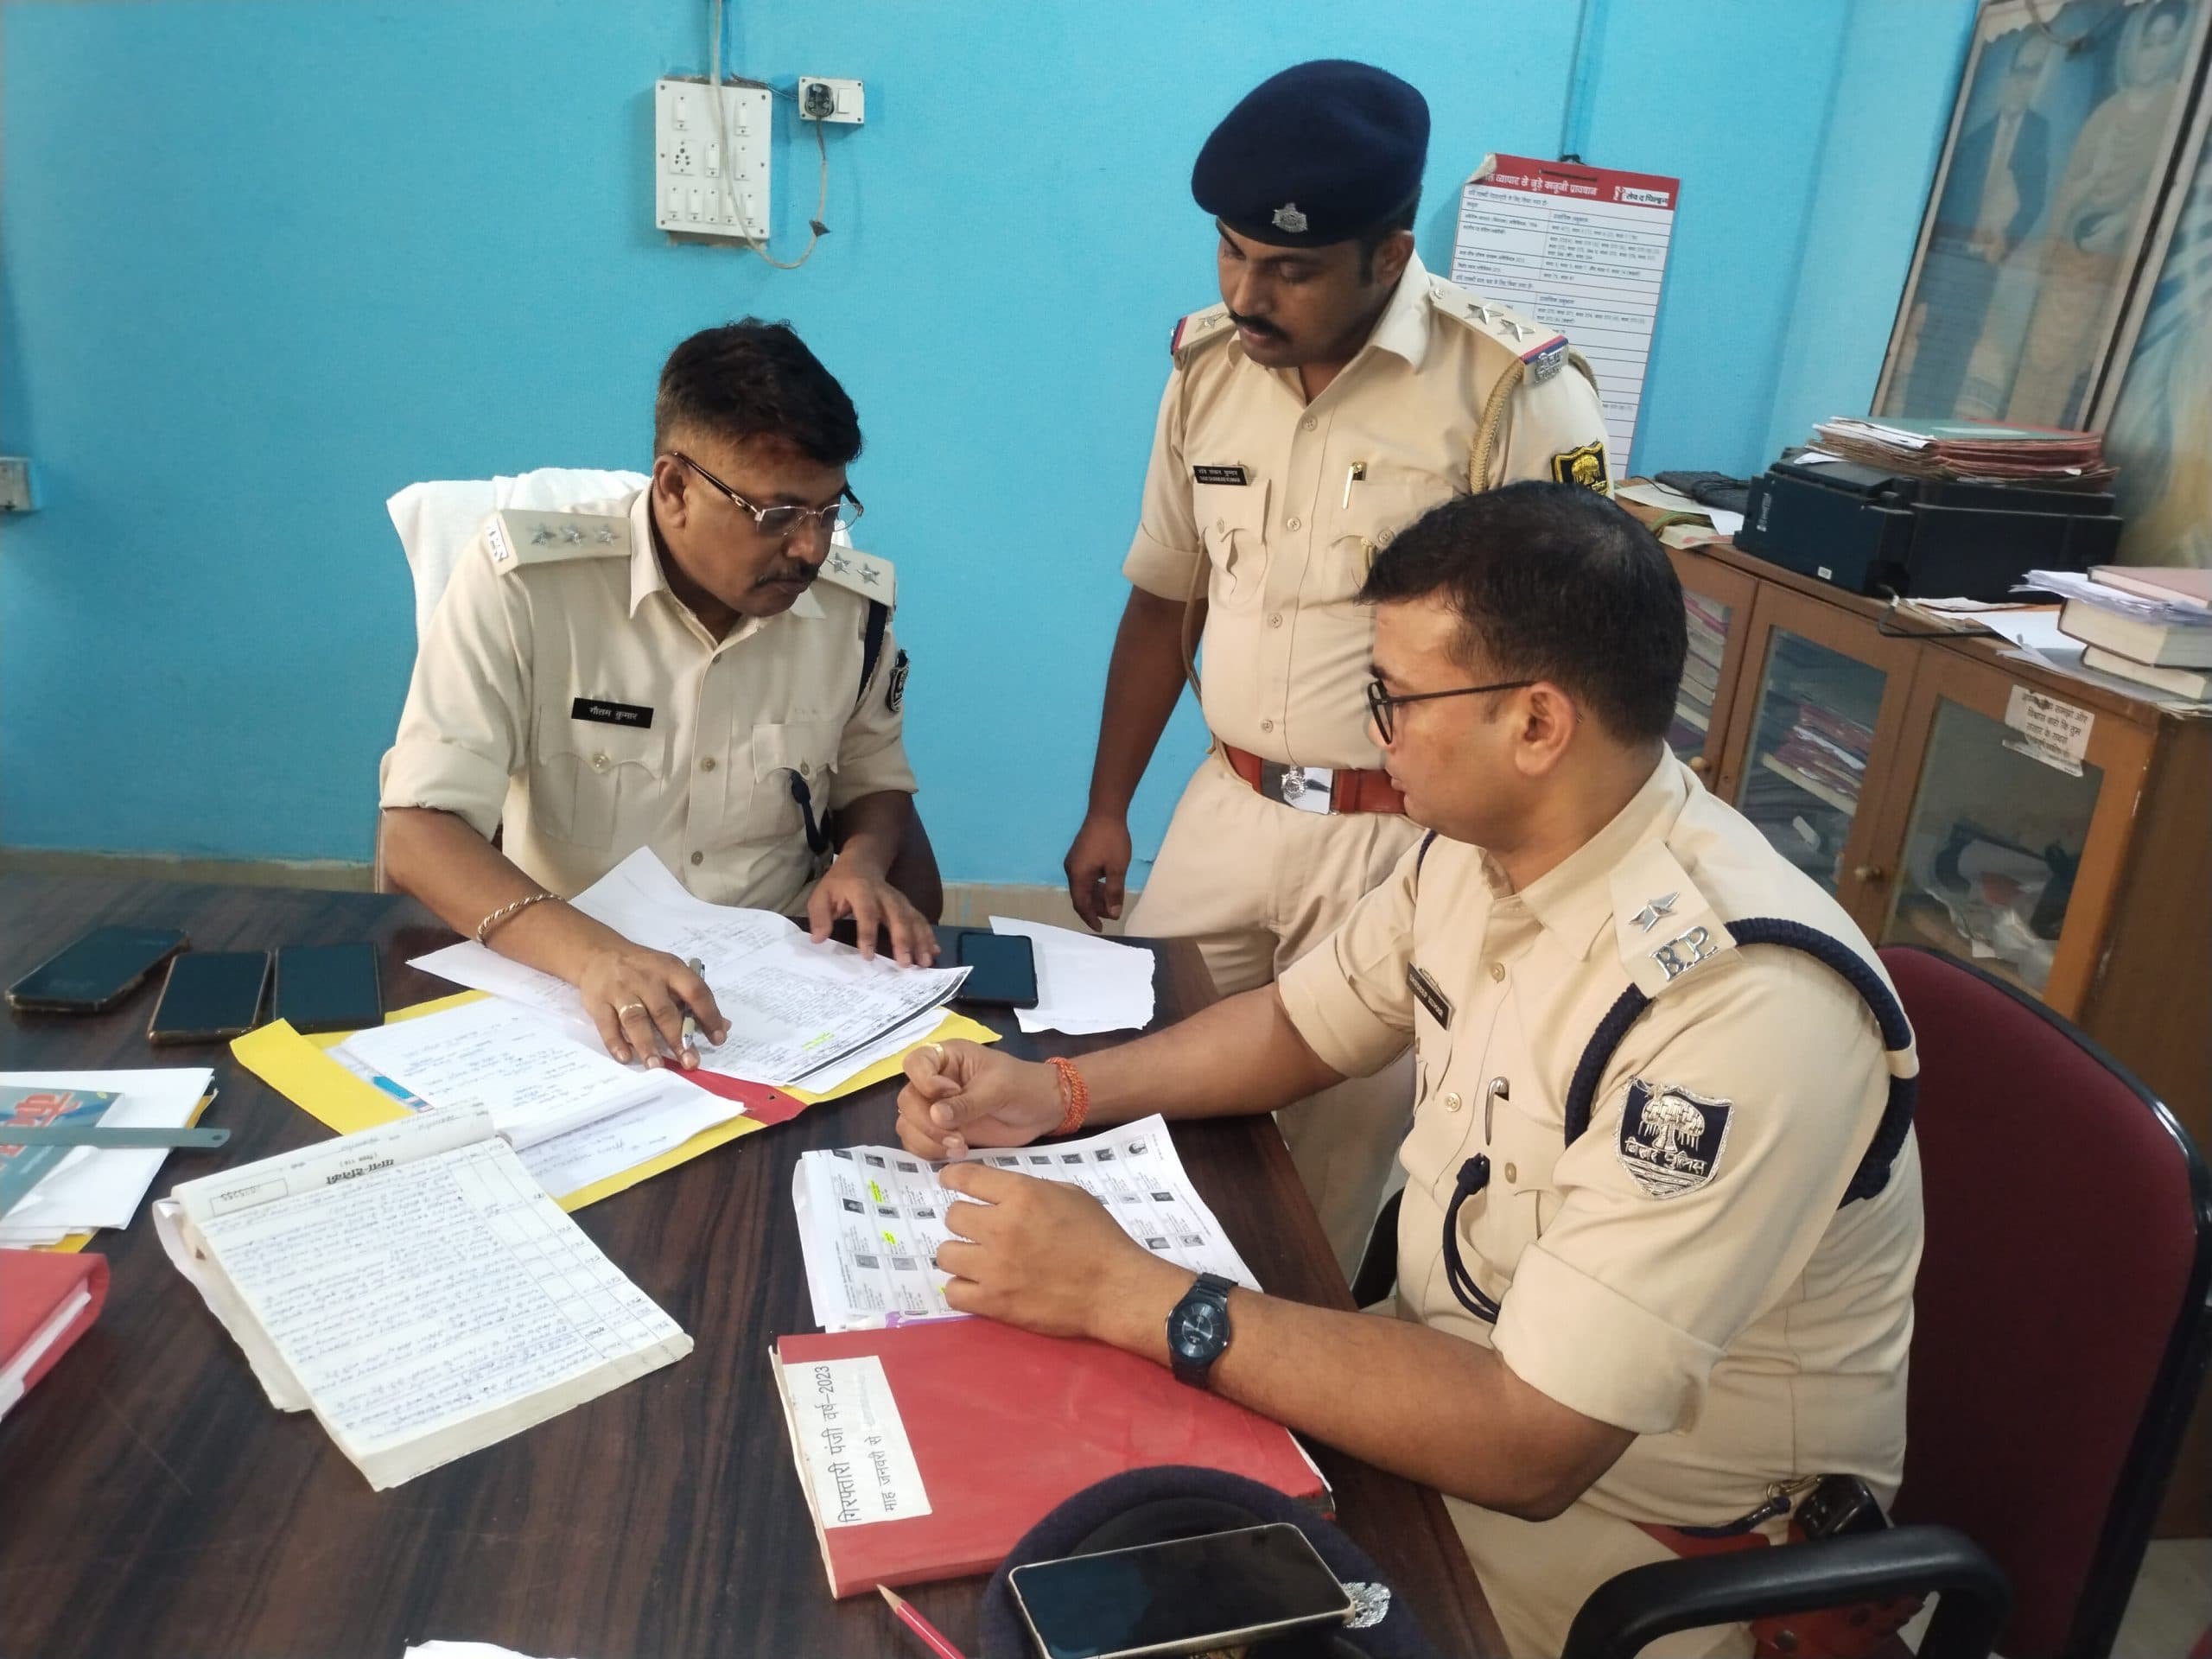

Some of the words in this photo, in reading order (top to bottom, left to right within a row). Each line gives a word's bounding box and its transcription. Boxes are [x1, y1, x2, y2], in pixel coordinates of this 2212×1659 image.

[1496, 174, 1520, 186] व्यापार
[1521, 175, 1529, 187] से
[1531, 178, 1543, 191] जुड़े
[1544, 180, 1569, 194] कानूनी
[1570, 184, 1598, 196] प्रावधान
[589, 706, 612, 717] गौतम
[615, 710, 638, 720] कुमार
[2075, 712, 2088, 724] और
[2069, 725, 2082, 736] तुम
[1624, 1136, 1661, 1164] बिहार
[1663, 1150, 1707, 1176] पुलिस
[821, 1427, 847, 1455] पंजी
[864, 1435, 882, 1446] से
[868, 1451, 891, 1487] जनवरी
[828, 1462, 862, 1522] गिरफ्तारी
[881, 1491, 898, 1513] माह
